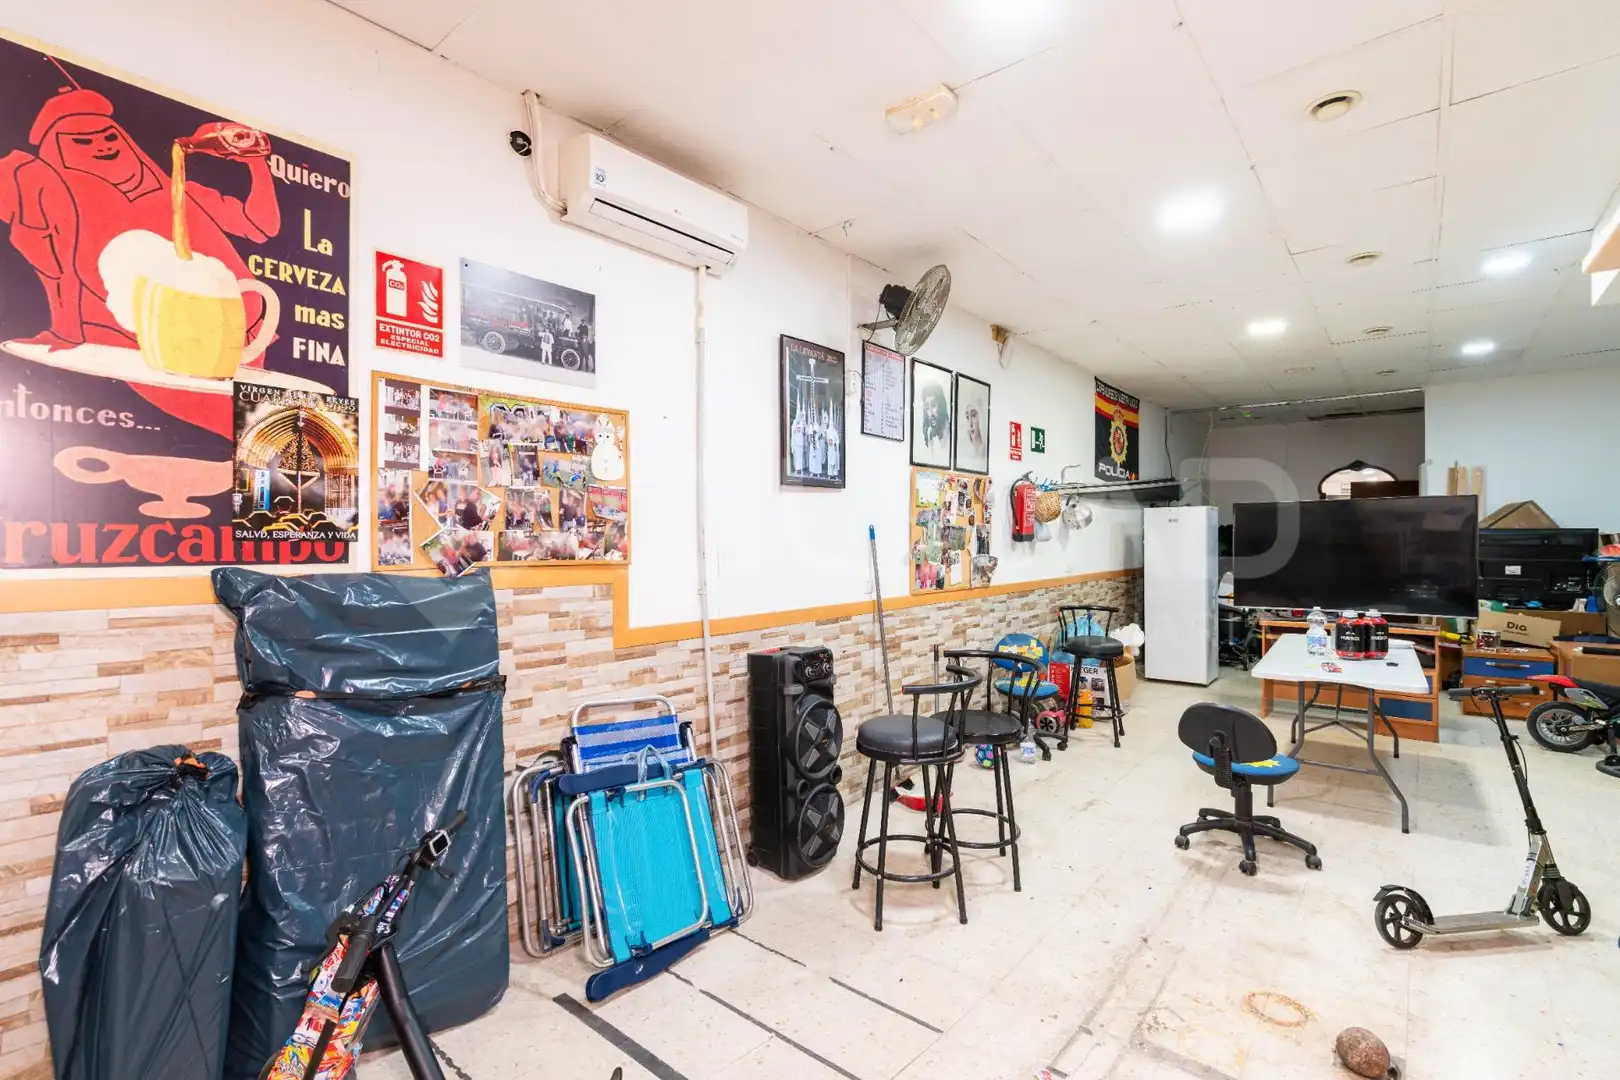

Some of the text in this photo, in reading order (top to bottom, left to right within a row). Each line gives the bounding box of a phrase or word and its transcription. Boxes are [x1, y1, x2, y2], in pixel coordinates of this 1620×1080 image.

[267, 154, 351, 198] Quiero
[304, 208, 333, 256] La
[248, 254, 346, 296] CERVEZA
[294, 304, 345, 330] mas
[379, 323, 440, 343] EXTINTOR CO2
[390, 334, 430, 347] ESPECIAL
[293, 336, 346, 367] FINA
[239, 384, 280, 396] VIRGEN
[272, 530, 326, 540] ESPERANZA
[335, 531, 356, 540] VIDA
